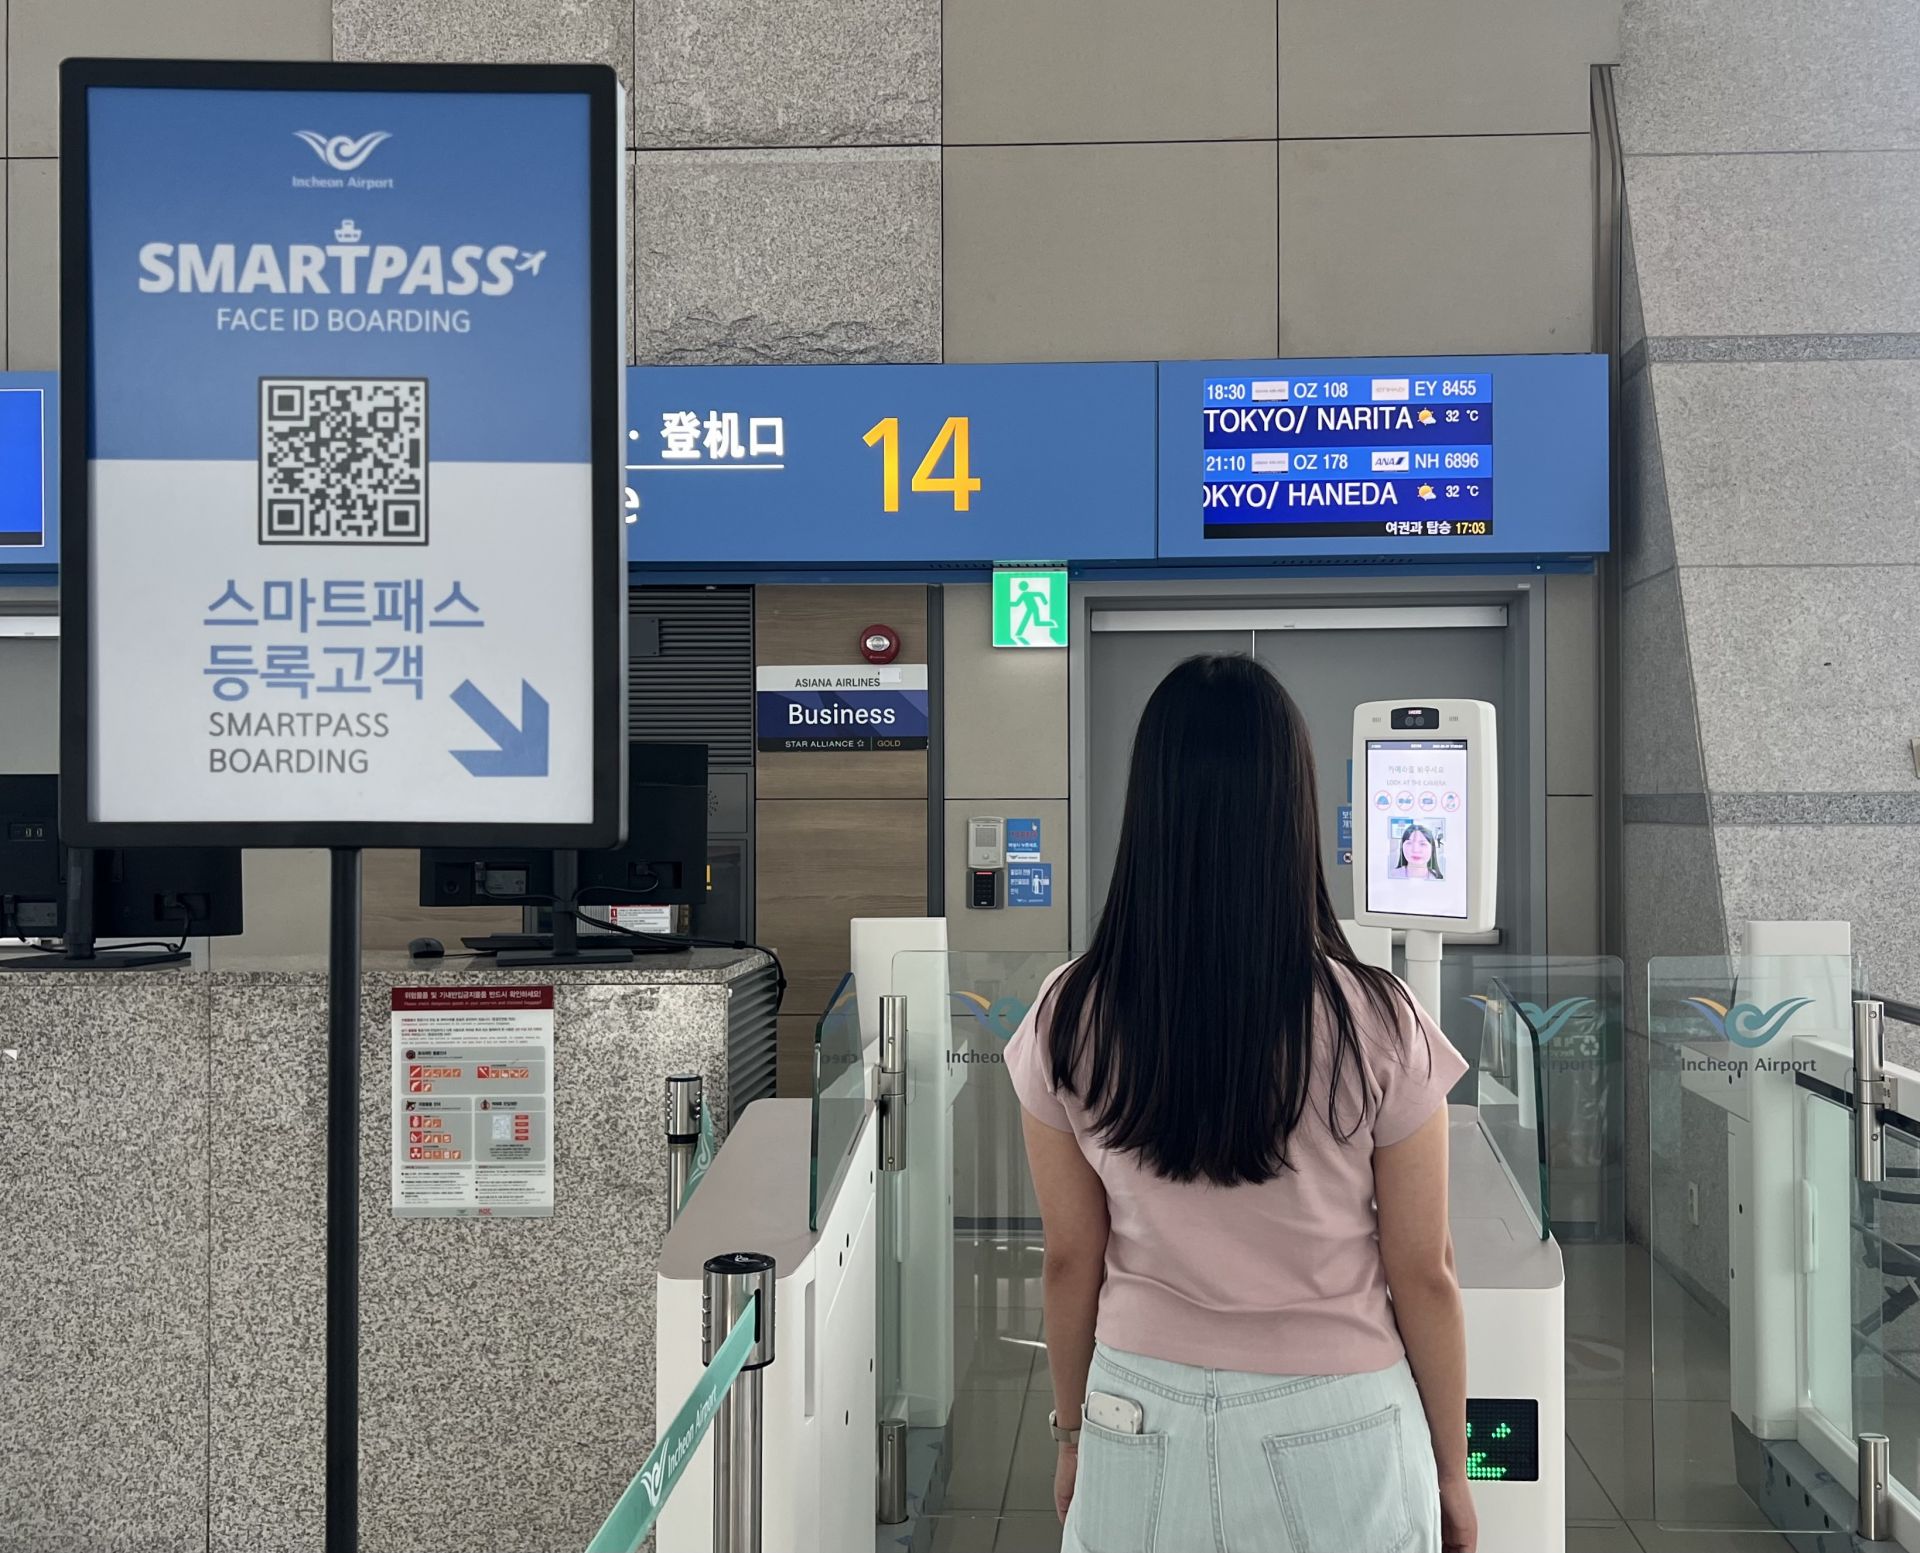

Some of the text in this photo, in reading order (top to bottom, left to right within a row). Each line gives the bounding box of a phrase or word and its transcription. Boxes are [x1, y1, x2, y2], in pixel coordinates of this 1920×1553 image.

[292, 176, 394, 190] Incheon Airport
[138, 242, 517, 296] SMARTPASS
[216, 308, 471, 333] FACE ID BOARDING
[1207, 384, 1246, 399] 18:30
[1293, 383, 1318, 398] OZ
[1323, 382, 1348, 398] 108
[1415, 381, 1437, 396] EY
[1442, 380, 1476, 396] 8455
[1204, 406, 1308, 434] TOKYO/
[1317, 406, 1414, 430] NARITA
[1445, 409, 1460, 422] 32
[660, 411, 785, 460] 登机口
[862, 416, 981, 512] 14
[1206, 456, 1246, 471] 21:10
[1293, 455, 1318, 470] OZ
[1323, 454, 1348, 470] 178
[1375, 457, 1396, 466] ANA
[1415, 454, 1440, 468] NH
[1444, 453, 1479, 468] 6896
[1288, 481, 1398, 507] HANEDA
[1445, 485, 1460, 498] 32
[1385, 521, 1485, 535] 여권과 탑승 17:03
[203, 578, 485, 634] 스마트패스
[203, 645, 424, 702] 등록고객
[795, 677, 881, 688] ASIANA AIRLINES
[208, 711, 390, 737] SMARTPASS
[788, 703, 896, 725] Business
[785, 739, 901, 748] STAR ALLIANCE GOLD
[208, 748, 369, 774] BOARDING
[1681, 1057, 1817, 1075] Incheon Airport
[667, 1383, 717, 1479] Incheon Airport
